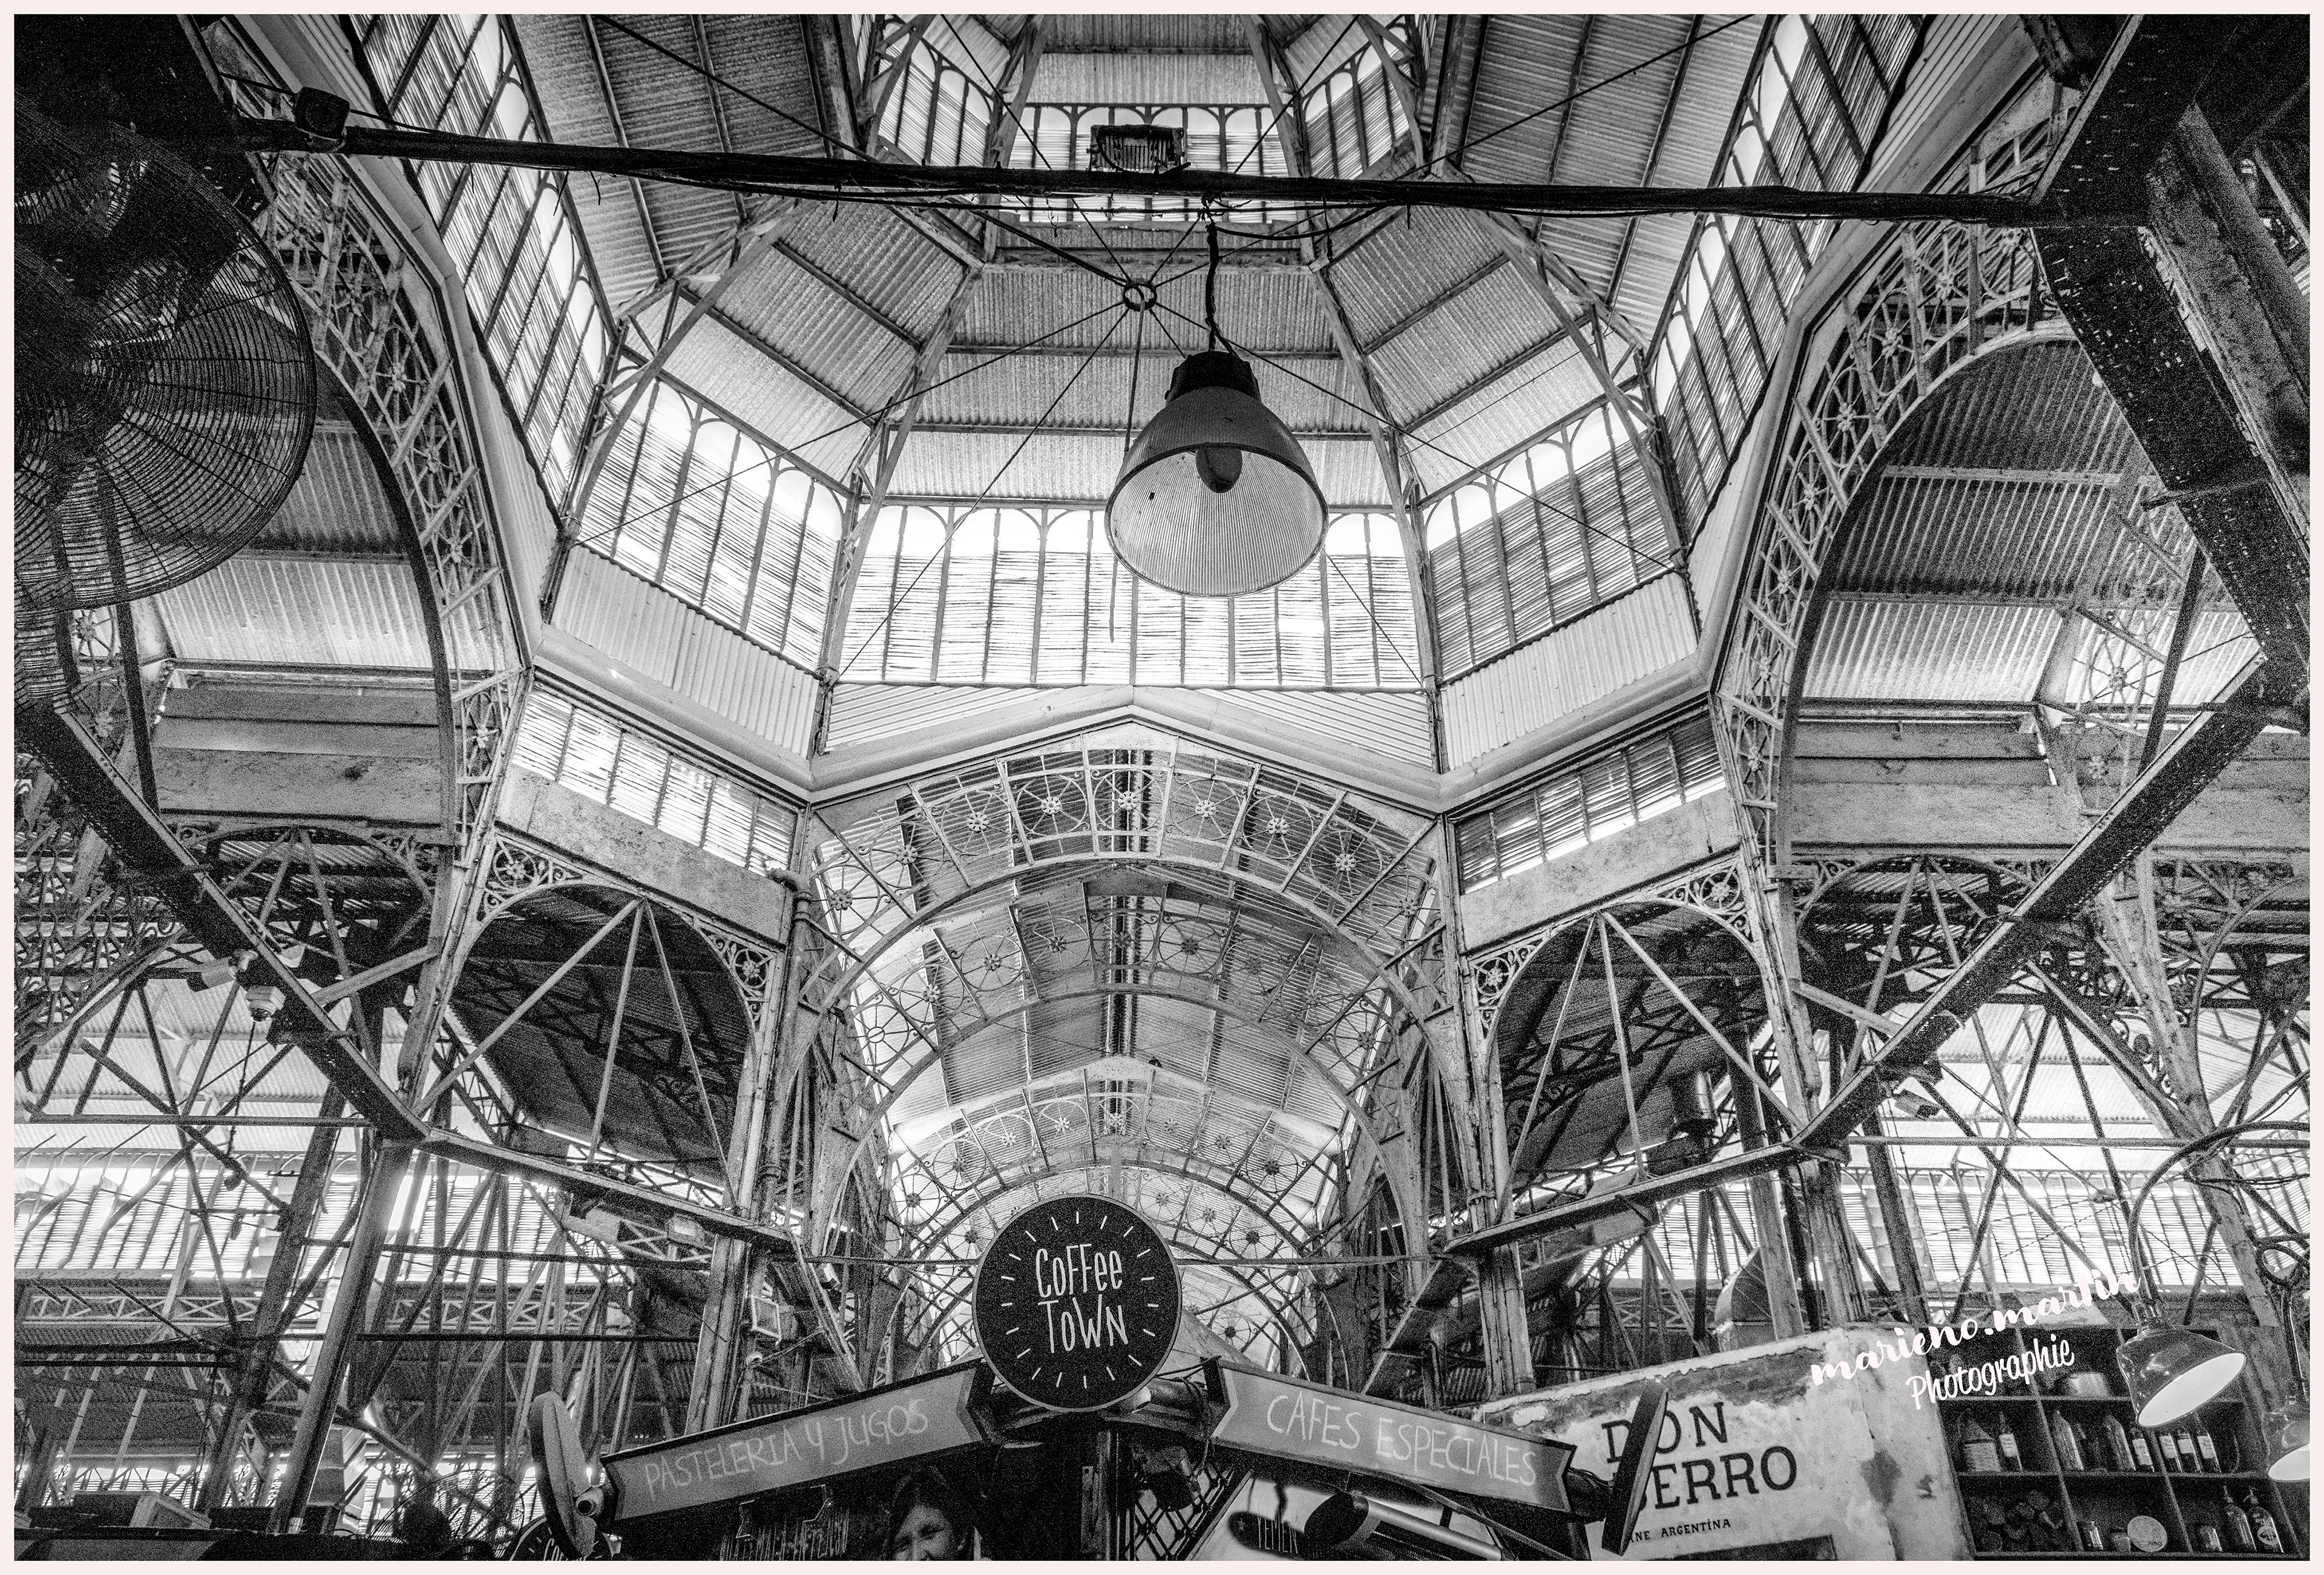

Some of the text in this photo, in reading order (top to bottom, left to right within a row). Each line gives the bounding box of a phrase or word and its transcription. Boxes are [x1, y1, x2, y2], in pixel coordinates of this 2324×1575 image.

[644, 1398, 930, 1502] PASTELERIA Y JUGOS
[1267, 1390, 1537, 1487] CAFES ESPECIALES
[1612, 1445, 1797, 1512] ERRO
